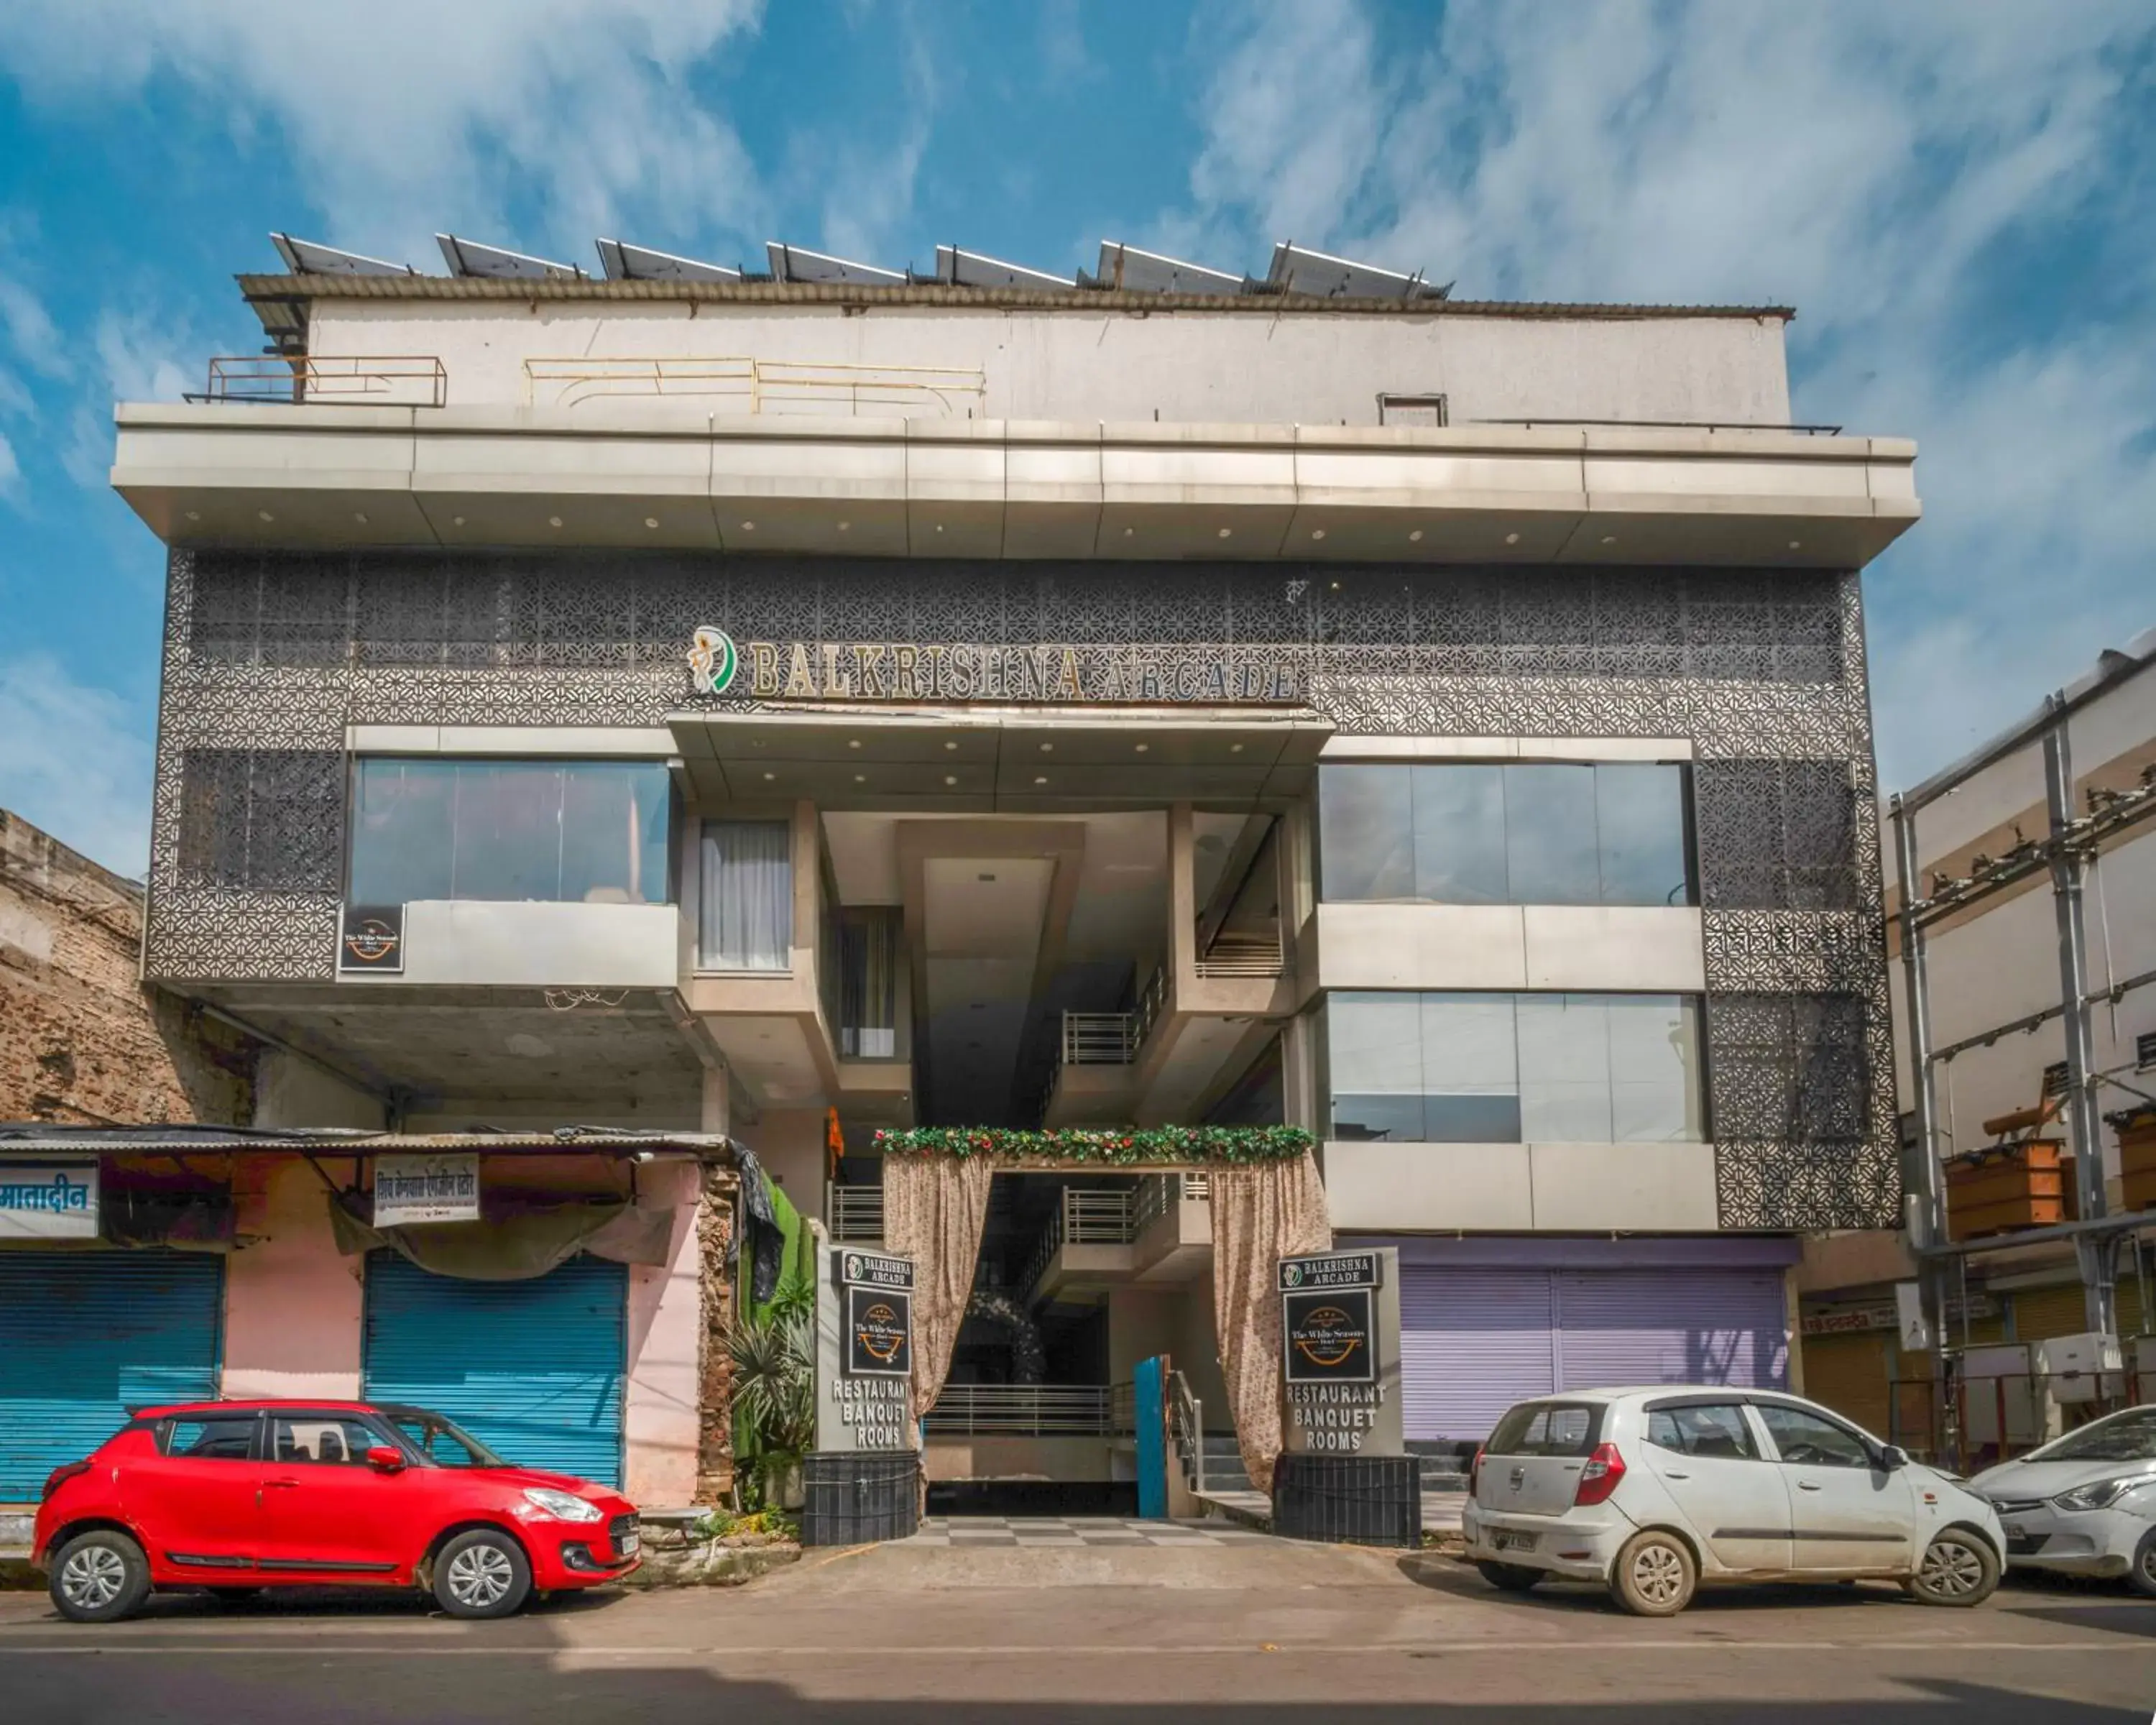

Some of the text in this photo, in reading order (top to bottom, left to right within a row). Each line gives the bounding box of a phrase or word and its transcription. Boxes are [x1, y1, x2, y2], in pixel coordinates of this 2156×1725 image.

[750, 642, 1299, 702] BALKRISHNA ARCADE
[0, 1172, 89, 1213] मातादीन
[864, 1256, 911, 1275] BALKRISHNA
[1304, 1258, 1369, 1274] BALKRISHNA
[871, 1271, 906, 1285] ARCADE
[1314, 1272, 1360, 1284] ARCADE
[1292, 1330, 1308, 1339] The
[1286, 1384, 1386, 1404] RESTAURANT
[842, 1402, 906, 1425] BANQUET
[1294, 1408, 1377, 1428] BANQUET
[857, 1425, 900, 1448] ROOMS
[1307, 1430, 1361, 1450] ROOMS
